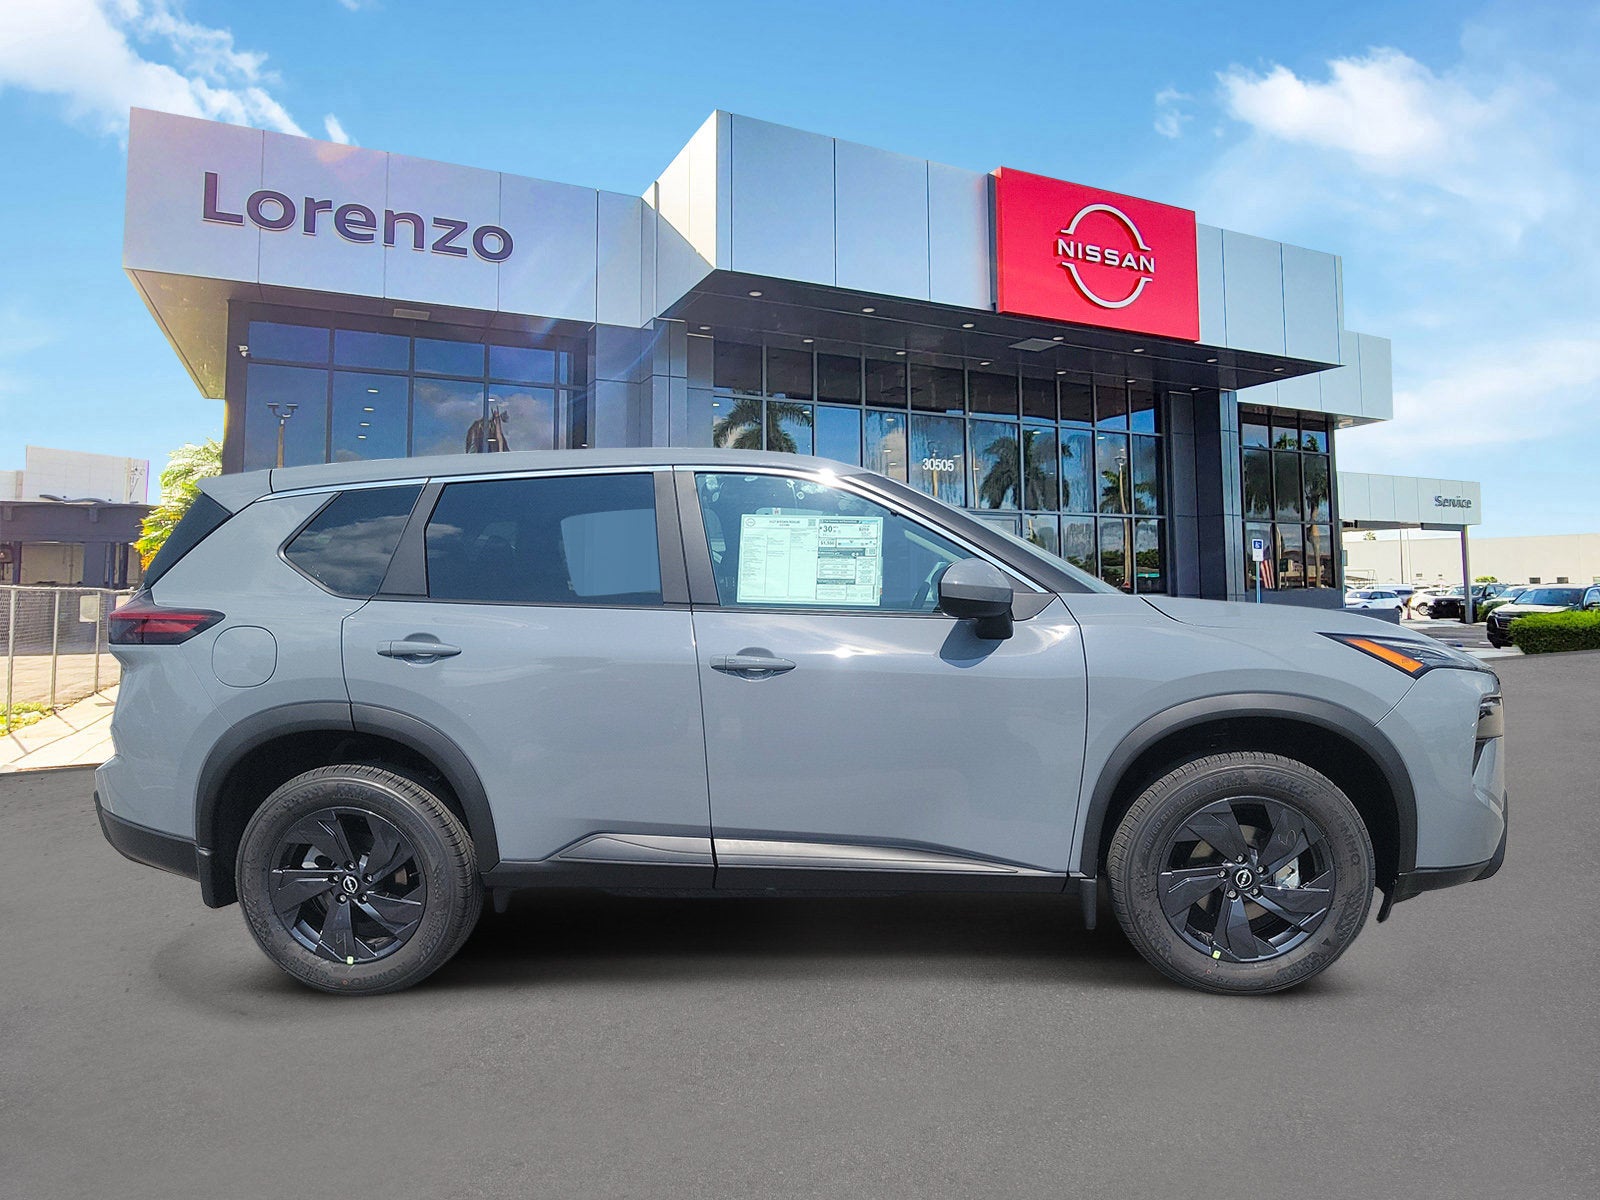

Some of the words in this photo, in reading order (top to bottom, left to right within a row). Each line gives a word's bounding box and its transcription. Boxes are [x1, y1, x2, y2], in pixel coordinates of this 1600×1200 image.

[202, 171, 514, 262] Lorenzo
[1057, 238, 1155, 273] NISSAN
[922, 458, 955, 472] 30505
[1434, 495, 1472, 508] Service
[823, 525, 833, 533] 30
